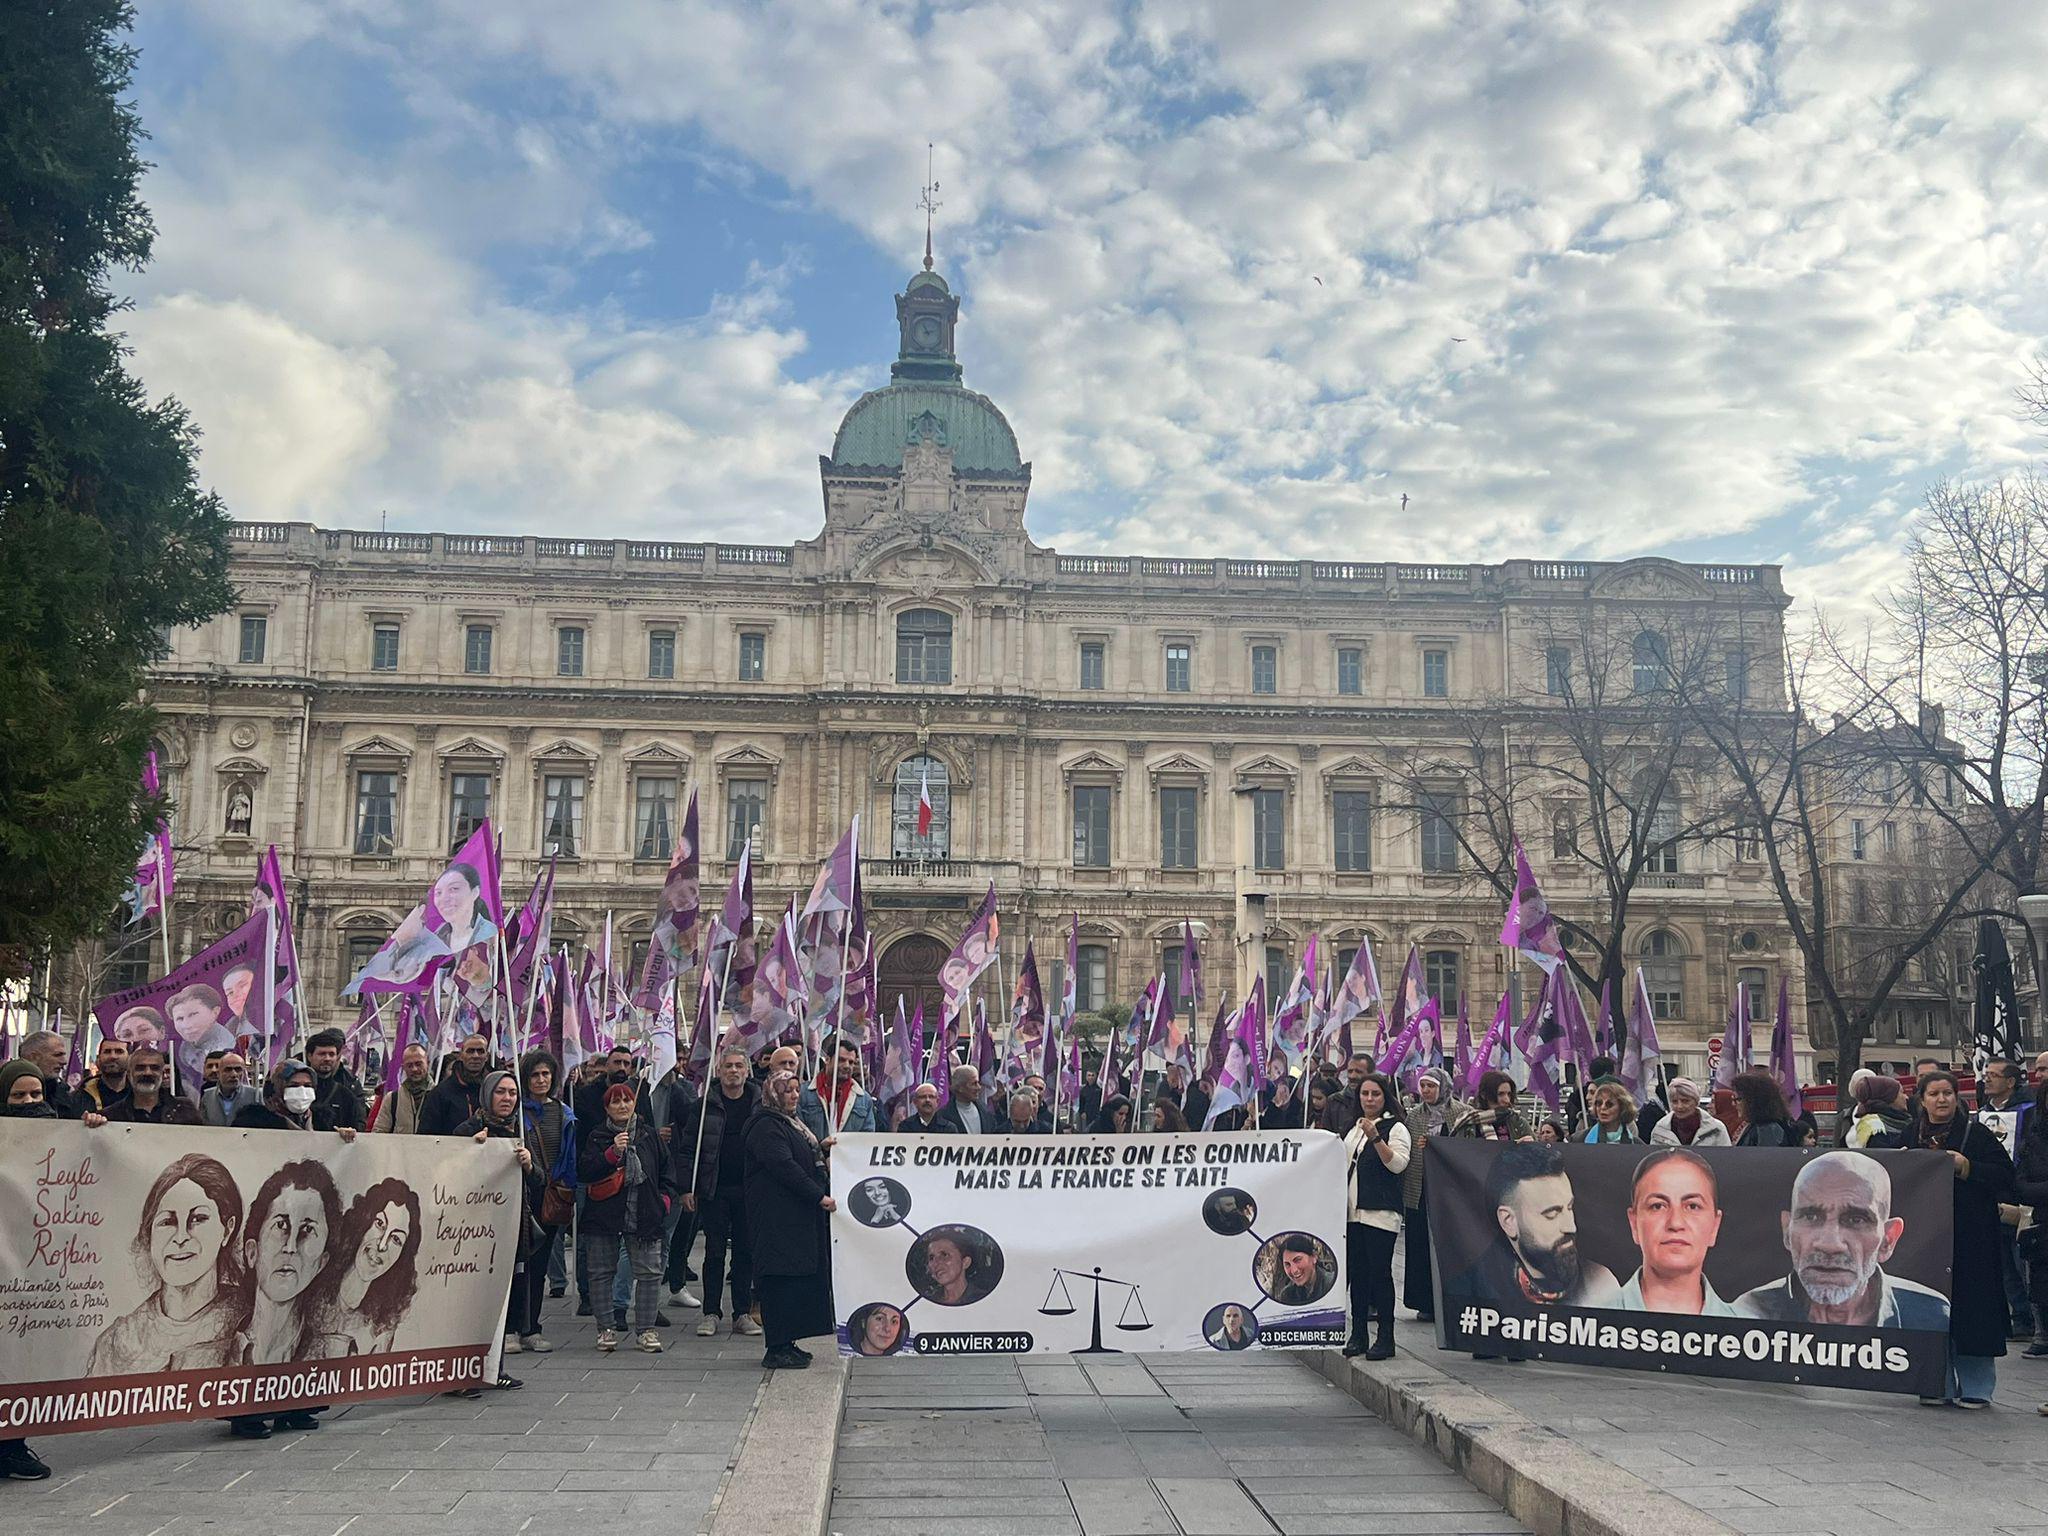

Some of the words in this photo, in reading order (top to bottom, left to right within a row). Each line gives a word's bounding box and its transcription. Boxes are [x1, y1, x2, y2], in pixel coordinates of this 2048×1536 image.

[869, 1147, 907, 1167] LES
[914, 1145, 1115, 1167] COMMANDITAIRES
[1122, 1146, 1153, 1165] ON
[1160, 1144, 1197, 1164] LES
[1205, 1139, 1302, 1164] CONNAÎT
[34, 1147, 101, 1200] Leyla
[954, 1169, 1013, 1190] MAIS
[1018, 1170, 1043, 1189] LA
[1051, 1168, 1135, 1189] FRANCE
[1142, 1167, 1170, 1187] SE
[1175, 1166, 1229, 1187] TAIT!
[33, 1187, 104, 1229] Sakine
[433, 1183, 459, 1206] Un
[465, 1184, 508, 1206] crime
[436, 1208, 496, 1256] toujours
[27, 1229, 103, 1279] Rojbîn
[425, 1254, 481, 1287] impuni
[487, 1242, 496, 1275] !
[66, 1275, 104, 1291] kurdes
[70, 1294, 79, 1308] à
[82, 1292, 110, 1309] Paris
[76, 1314, 104, 1328] 2013
[920, 1338, 929, 1350] 9
[996, 1336, 1029, 1350] 2013
[1261, 1332, 1273, 1343] 23
[1274, 1331, 1328, 1343] DECEMBRE
[1459, 1306, 1910, 1373] #ParisMassacreOfKurds
[0, 1383, 193, 1428] COMMANDITAIRE,
[198, 1377, 250, 1408] C'EST
[253, 1366, 346, 1403] ERDOĞAN.
[349, 1369, 365, 1393] IL
[368, 1363, 405, 1389] DOIT
[409, 1356, 445, 1386] ÊTRE
[447, 1355, 487, 1382] JUG
